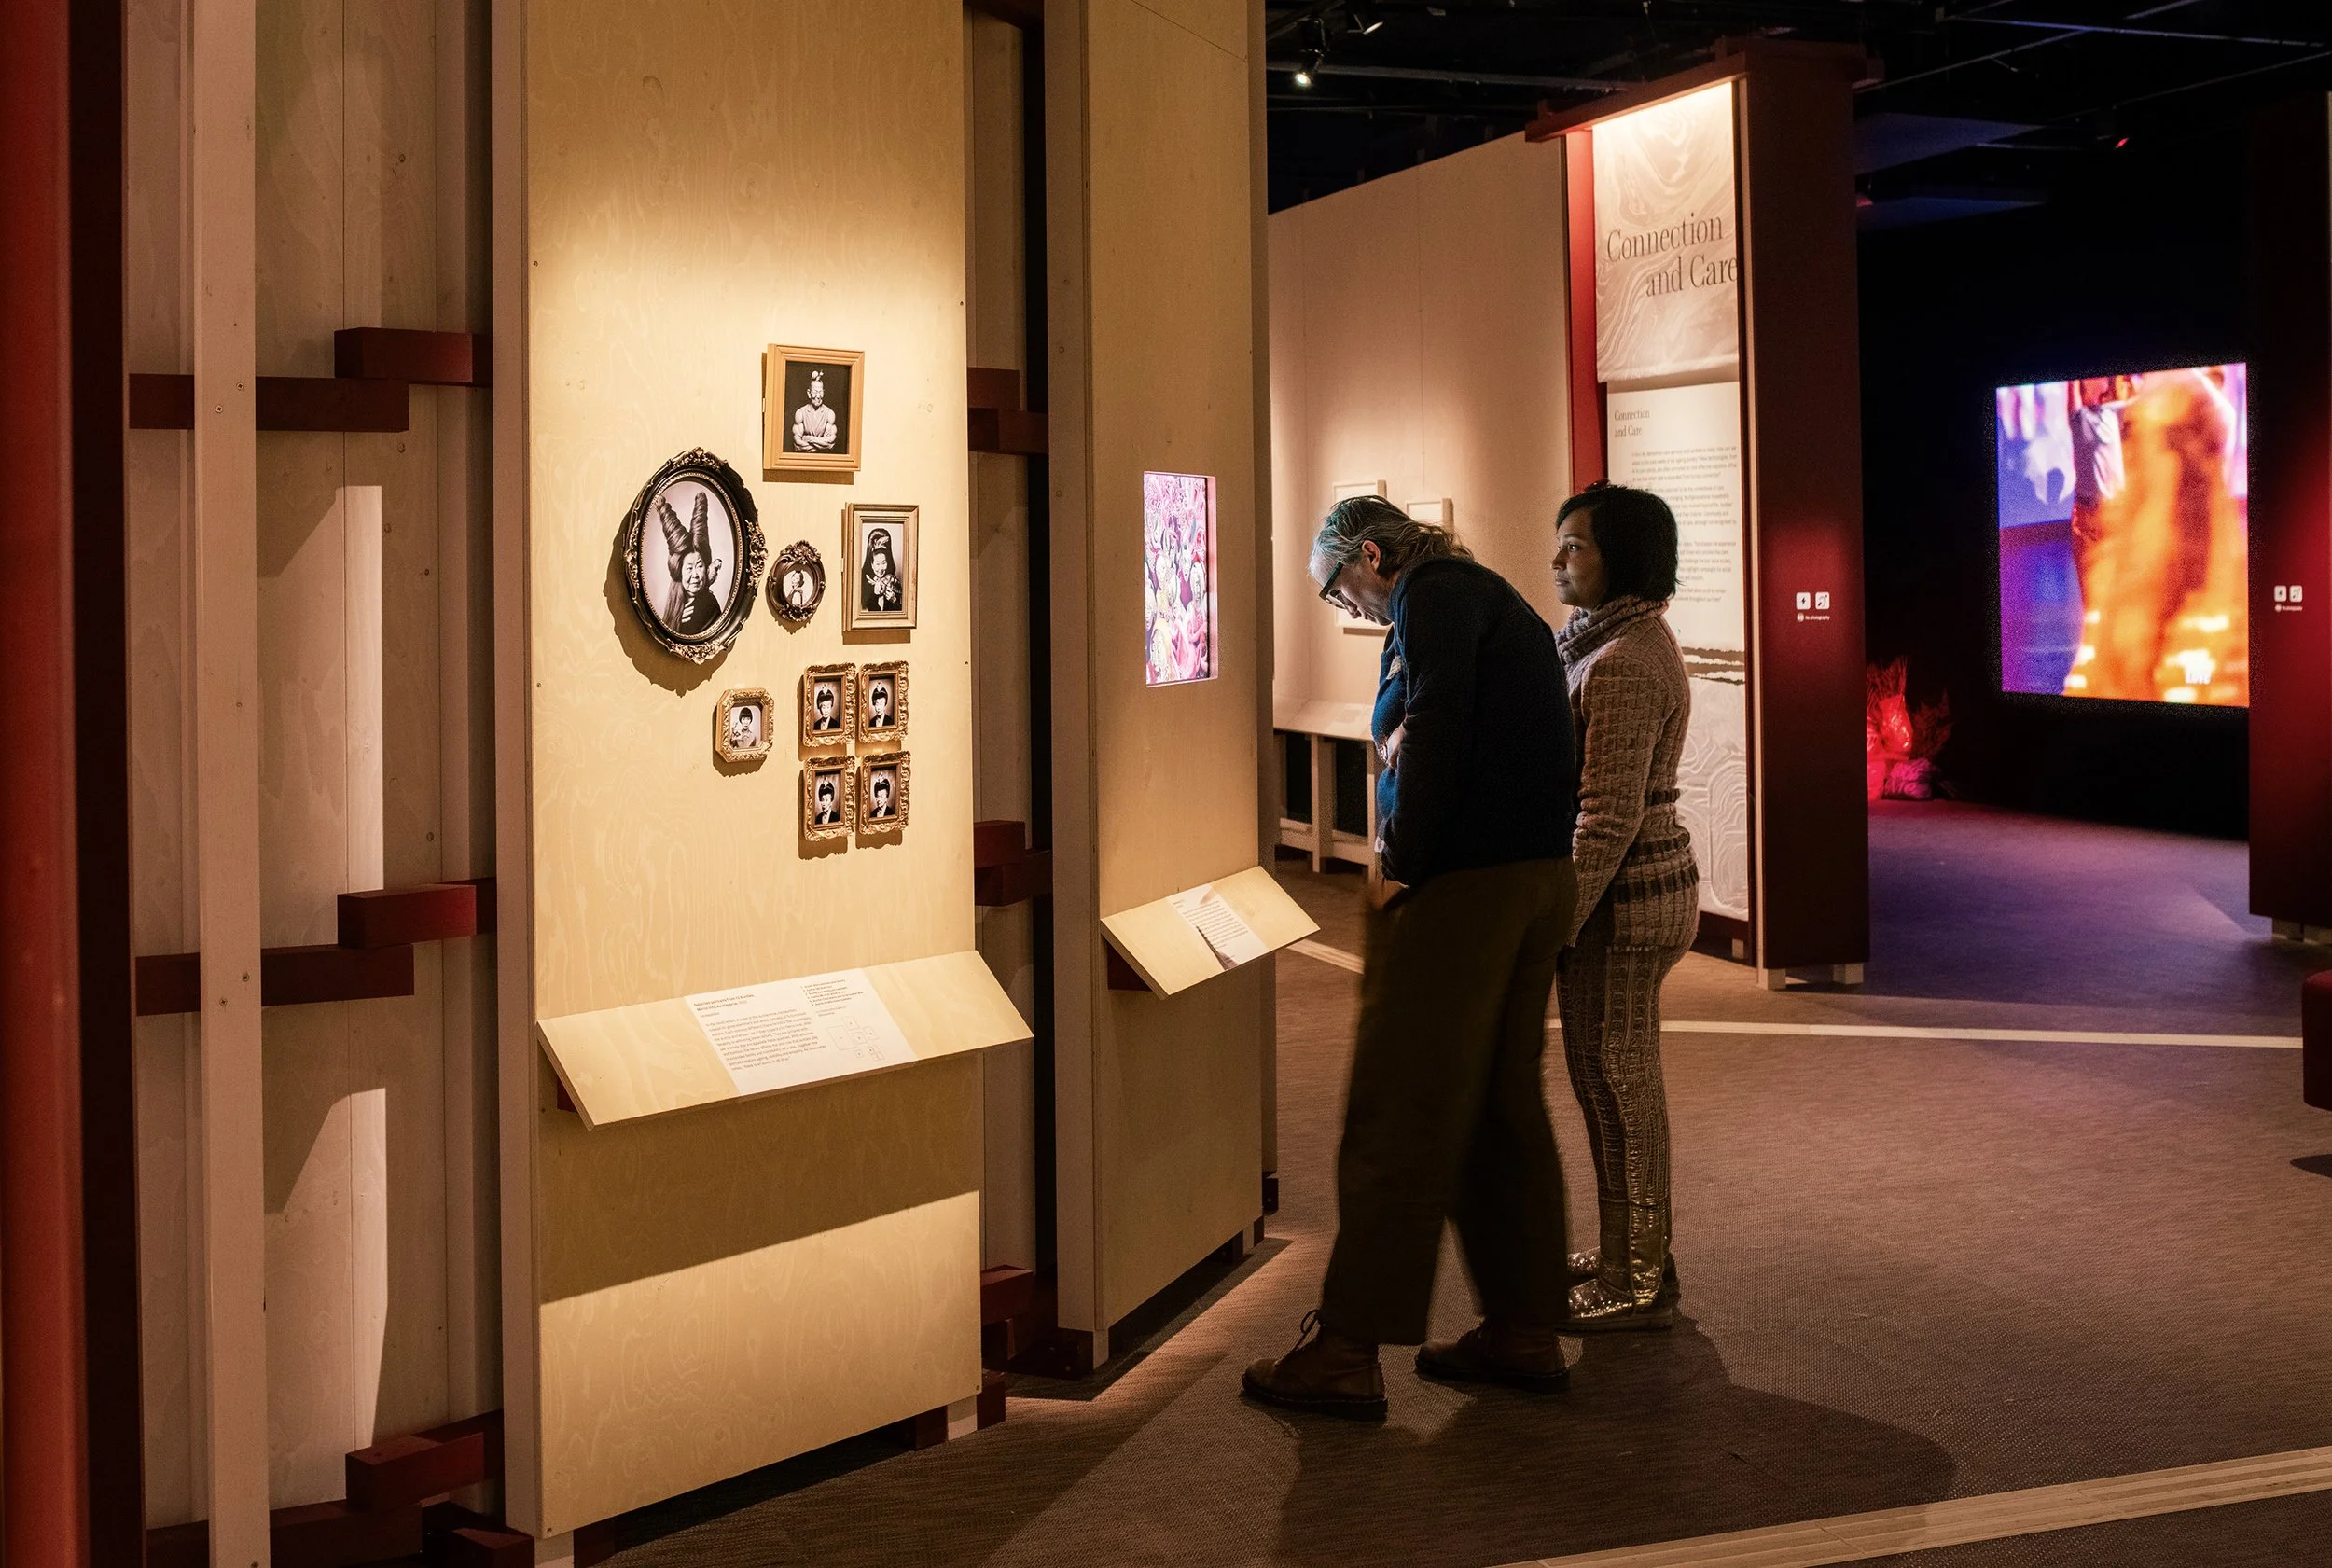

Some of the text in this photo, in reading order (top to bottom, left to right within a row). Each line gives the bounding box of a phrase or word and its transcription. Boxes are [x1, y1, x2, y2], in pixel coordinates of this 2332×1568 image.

[1607, 212, 1724, 262] Connection
[1645, 254, 1738, 298] and Care
[1614, 408, 1650, 422] Connection
[1614, 424, 1643, 438] and Care
